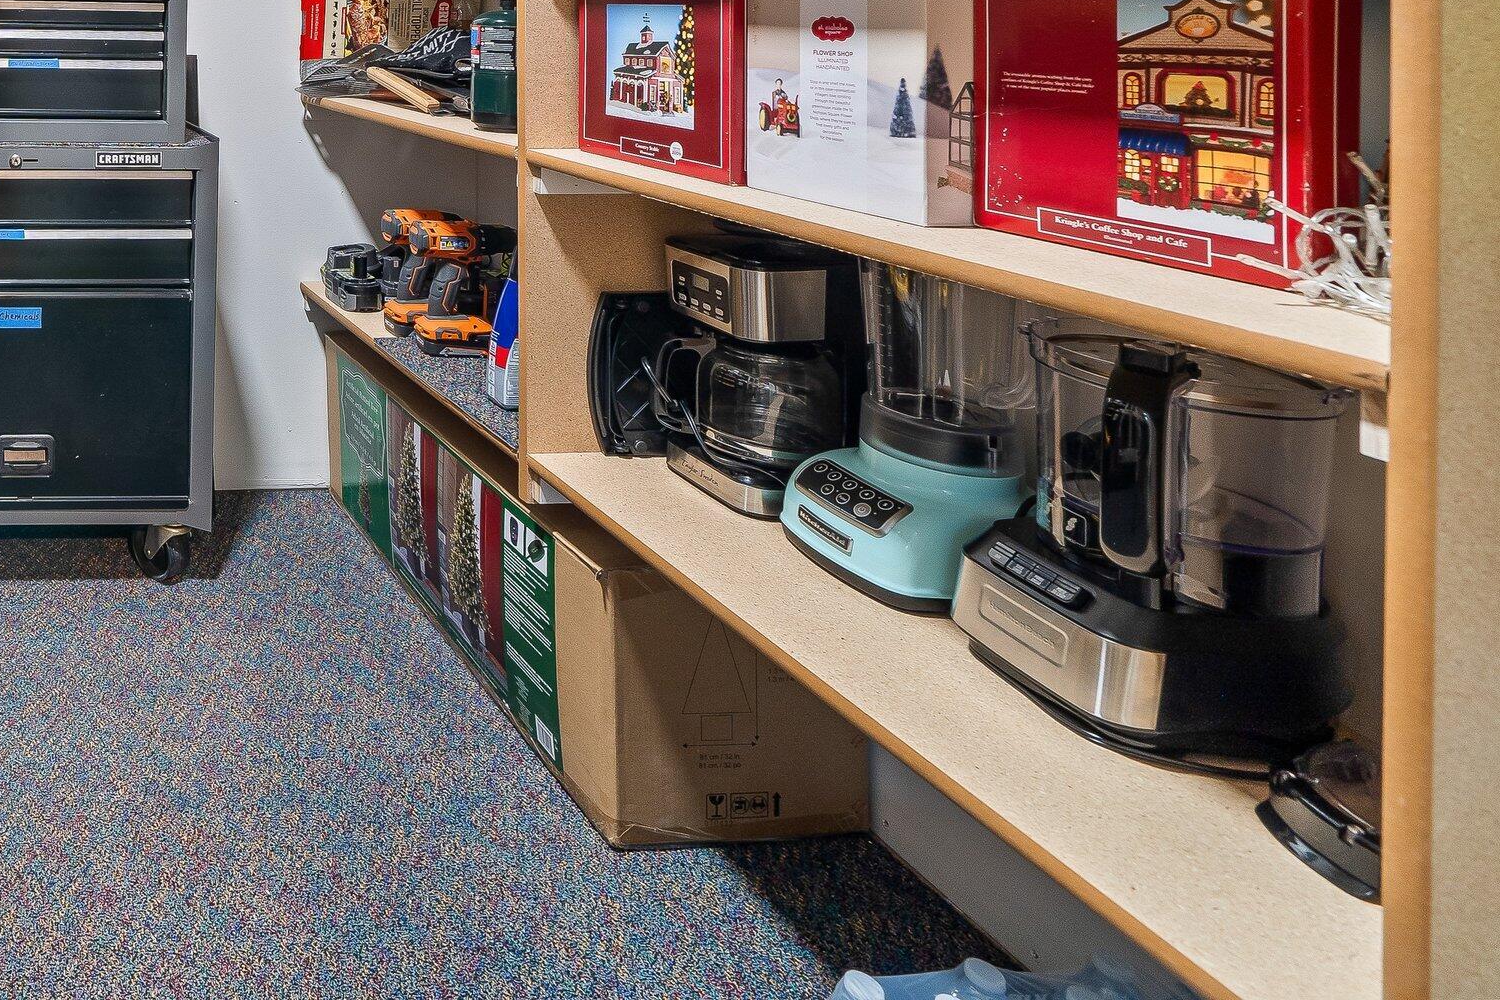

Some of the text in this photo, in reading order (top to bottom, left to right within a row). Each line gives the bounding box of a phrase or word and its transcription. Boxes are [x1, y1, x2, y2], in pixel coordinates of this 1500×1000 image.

[812, 49, 837, 57] FLOWER
[817, 57, 849, 65] ILLUMINATED
[815, 64, 851, 72] HANDPAINTED
[99, 155, 159, 165] CRAFTSMAN
[1054, 215, 1188, 248] Kringle's Coffee Shop and Cafe
[0, 312, 40, 322] Chemicals
